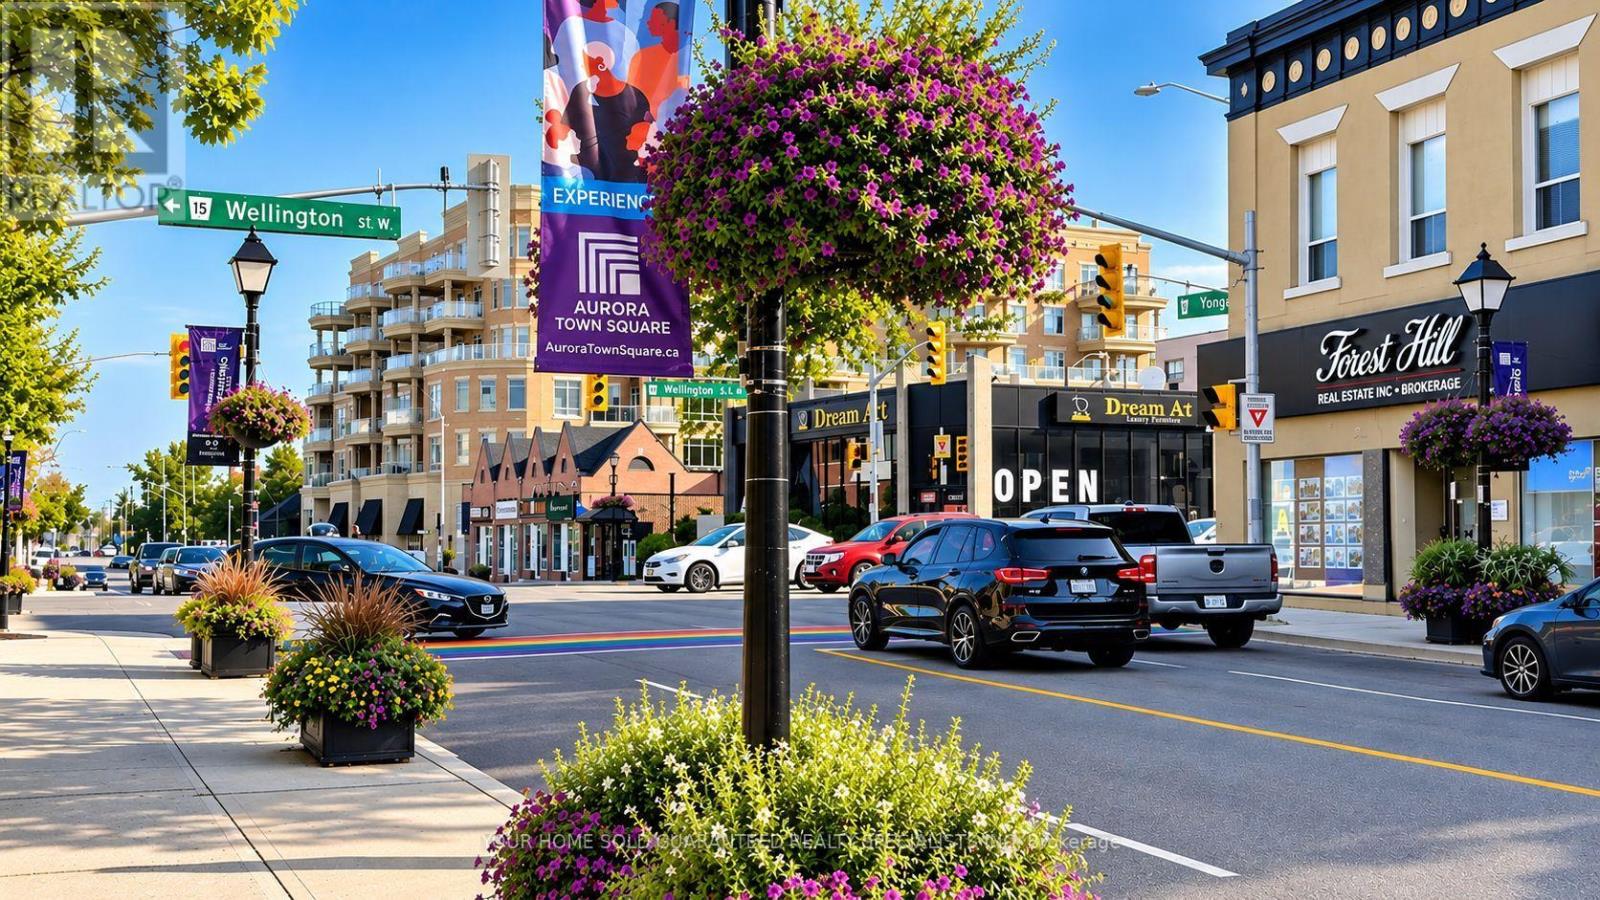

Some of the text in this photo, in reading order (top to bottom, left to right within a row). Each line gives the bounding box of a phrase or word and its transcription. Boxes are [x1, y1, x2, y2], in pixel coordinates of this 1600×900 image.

[193, 201, 207, 215] 15
[225, 199, 343, 229] Wellington
[574, 300, 650, 317] AURORA
[555, 317, 671, 334] TOWN SQUARE
[545, 341, 679, 358] AuroraTownSquare.ca
[1316, 313, 1464, 382] Forest Hill
[664, 384, 714, 397] Wellington
[1317, 377, 1461, 405] REAL ESTATE INC BROKERAGE
[1104, 397, 1193, 417] Dream At
[814, 408, 859, 428] Dream
[994, 468, 1098, 503] OPEN
